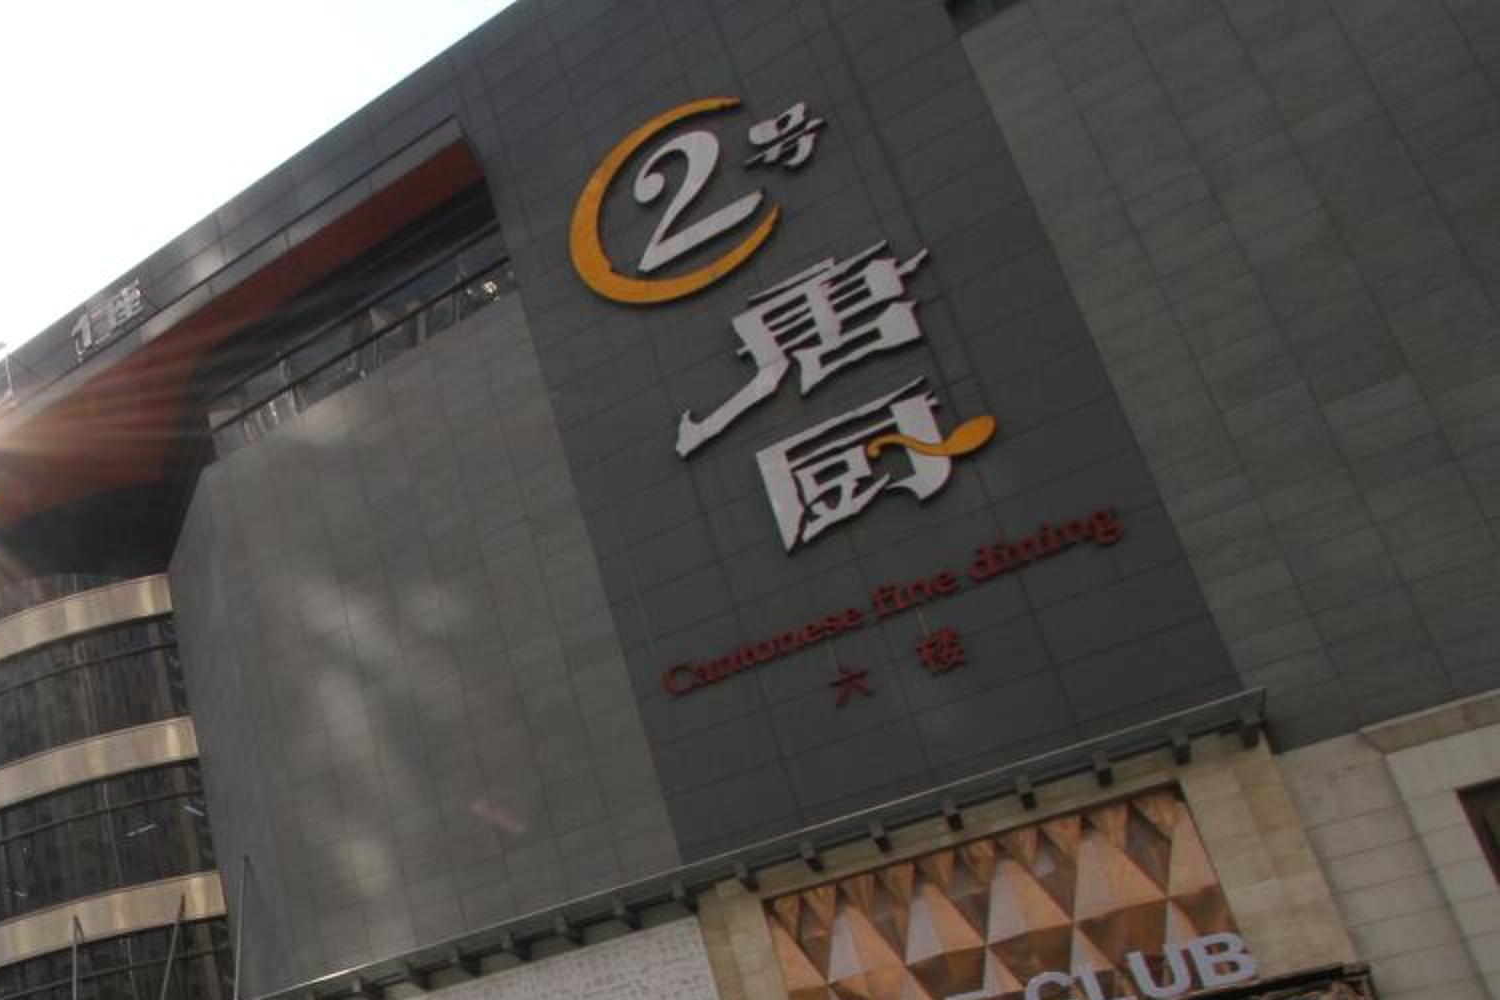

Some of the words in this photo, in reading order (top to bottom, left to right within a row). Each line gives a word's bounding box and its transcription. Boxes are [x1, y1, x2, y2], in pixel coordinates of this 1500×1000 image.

[663, 606, 863, 694] Cantonese
[871, 569, 959, 621] fine
[967, 508, 1123, 583] dining
